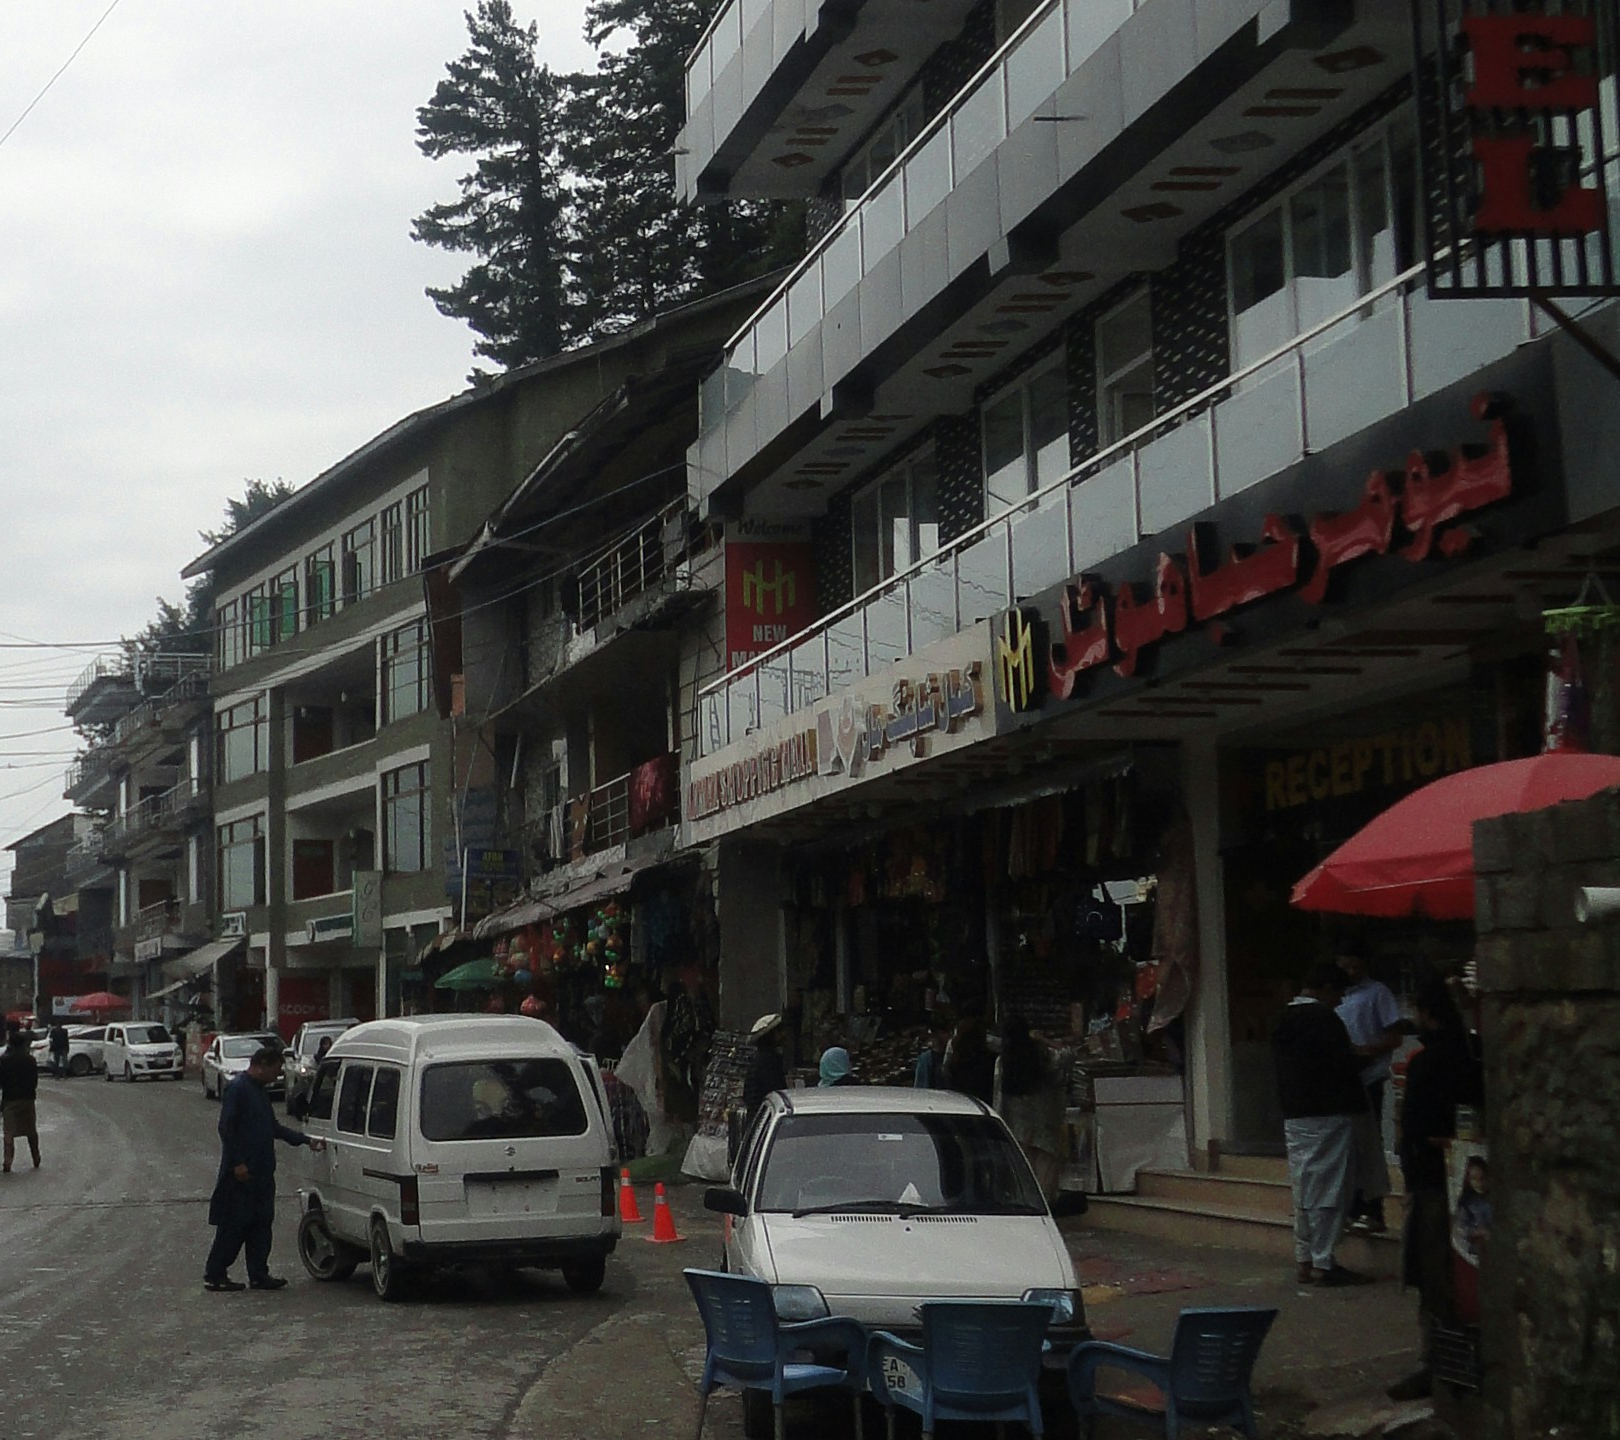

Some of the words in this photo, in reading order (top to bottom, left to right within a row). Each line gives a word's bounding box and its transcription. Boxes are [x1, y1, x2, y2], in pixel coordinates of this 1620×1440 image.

[752, 623, 787, 643] NEW
[718, 744, 780, 808] SHOPPING
[1264, 715, 1474, 812] RECEPTION
